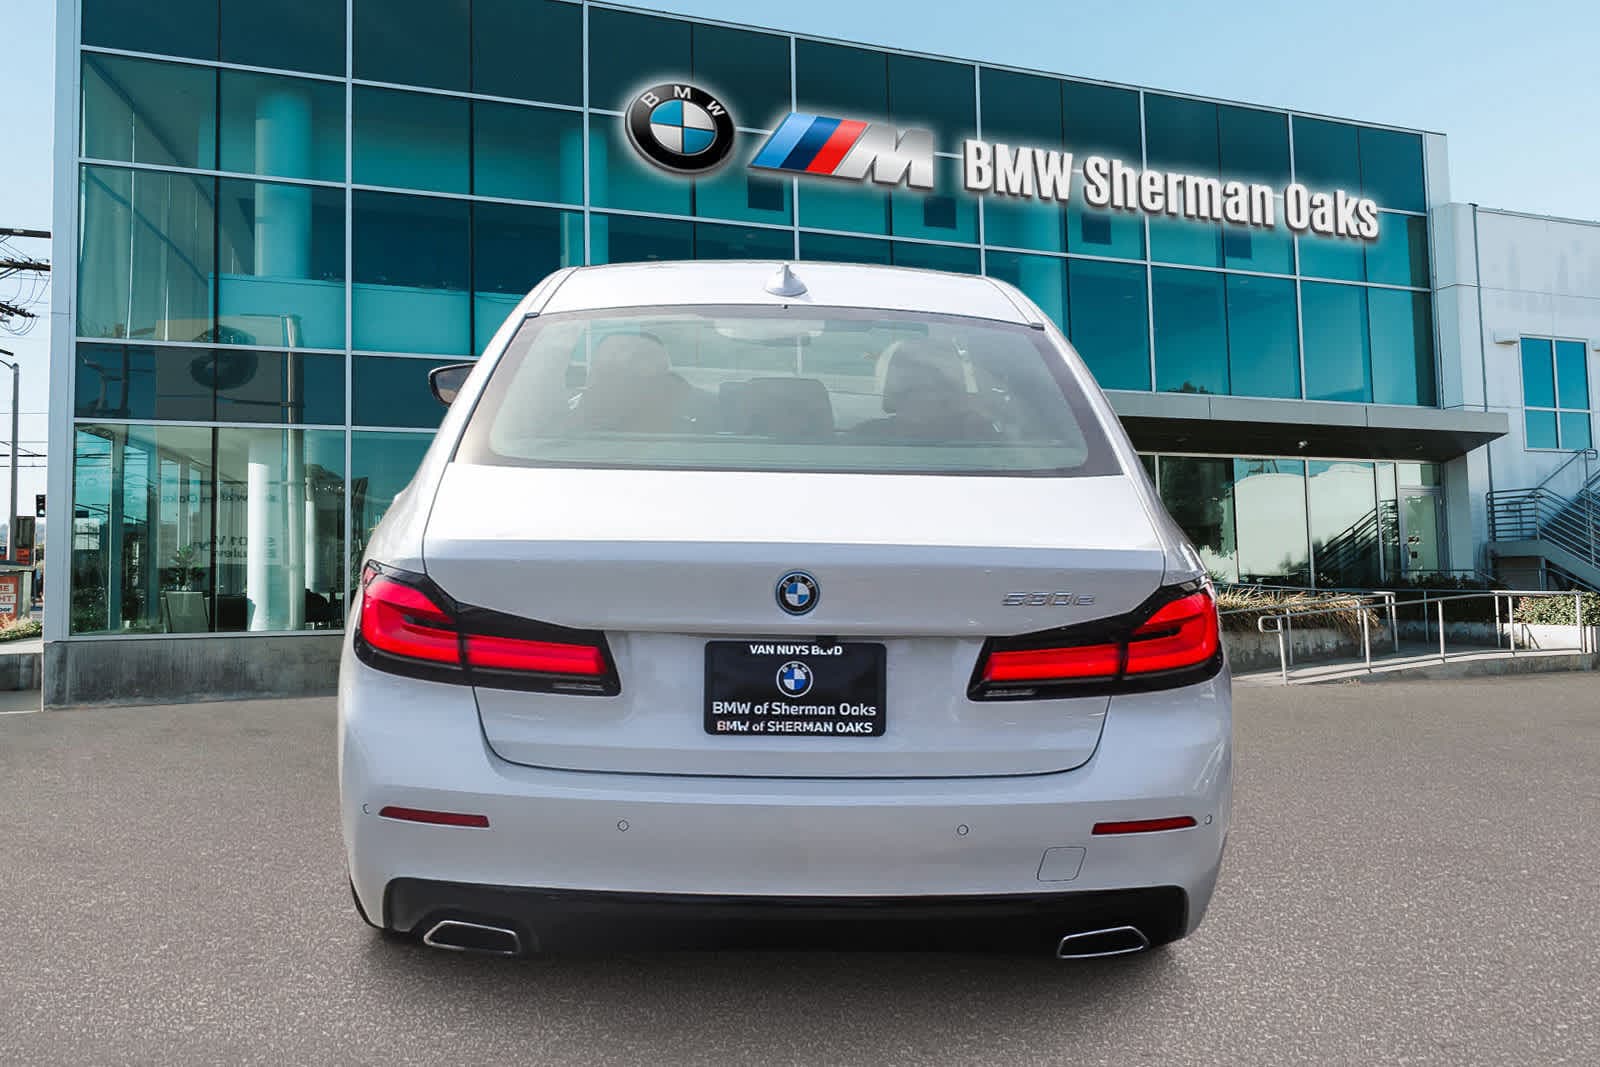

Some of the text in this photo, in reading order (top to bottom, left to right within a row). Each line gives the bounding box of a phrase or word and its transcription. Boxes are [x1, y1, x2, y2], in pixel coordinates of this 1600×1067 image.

[641, 85, 725, 117] BMW
[964, 139, 1379, 241] BMW Sherman Oaks
[749, 644, 775, 655] VAN
[776, 644, 810, 655] NUYS
[712, 701, 877, 716] BMW of Sherman Oaks
[716, 720, 873, 733] BMW of SHERMAN OAKS
